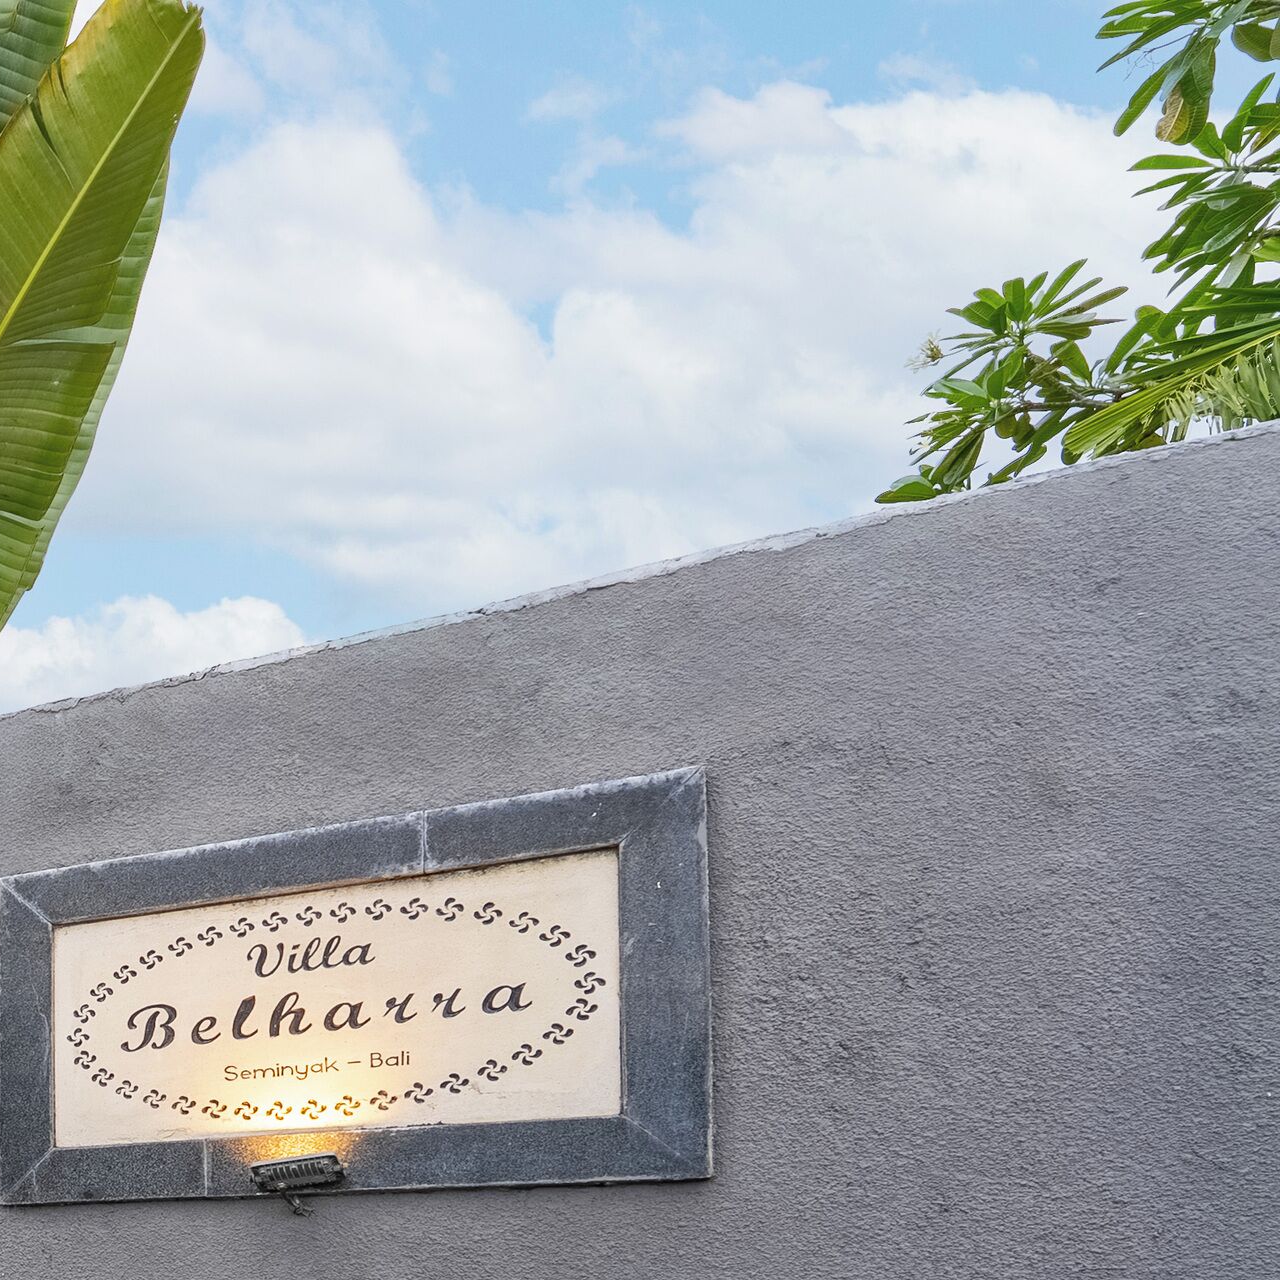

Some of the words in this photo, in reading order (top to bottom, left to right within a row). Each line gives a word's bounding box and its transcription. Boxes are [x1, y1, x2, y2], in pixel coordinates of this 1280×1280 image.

[246, 934, 376, 978] Villa
[120, 981, 534, 1053] Belharra
[223, 1057, 340, 1082] Seminyak
[369, 1050, 411, 1069] Bali
